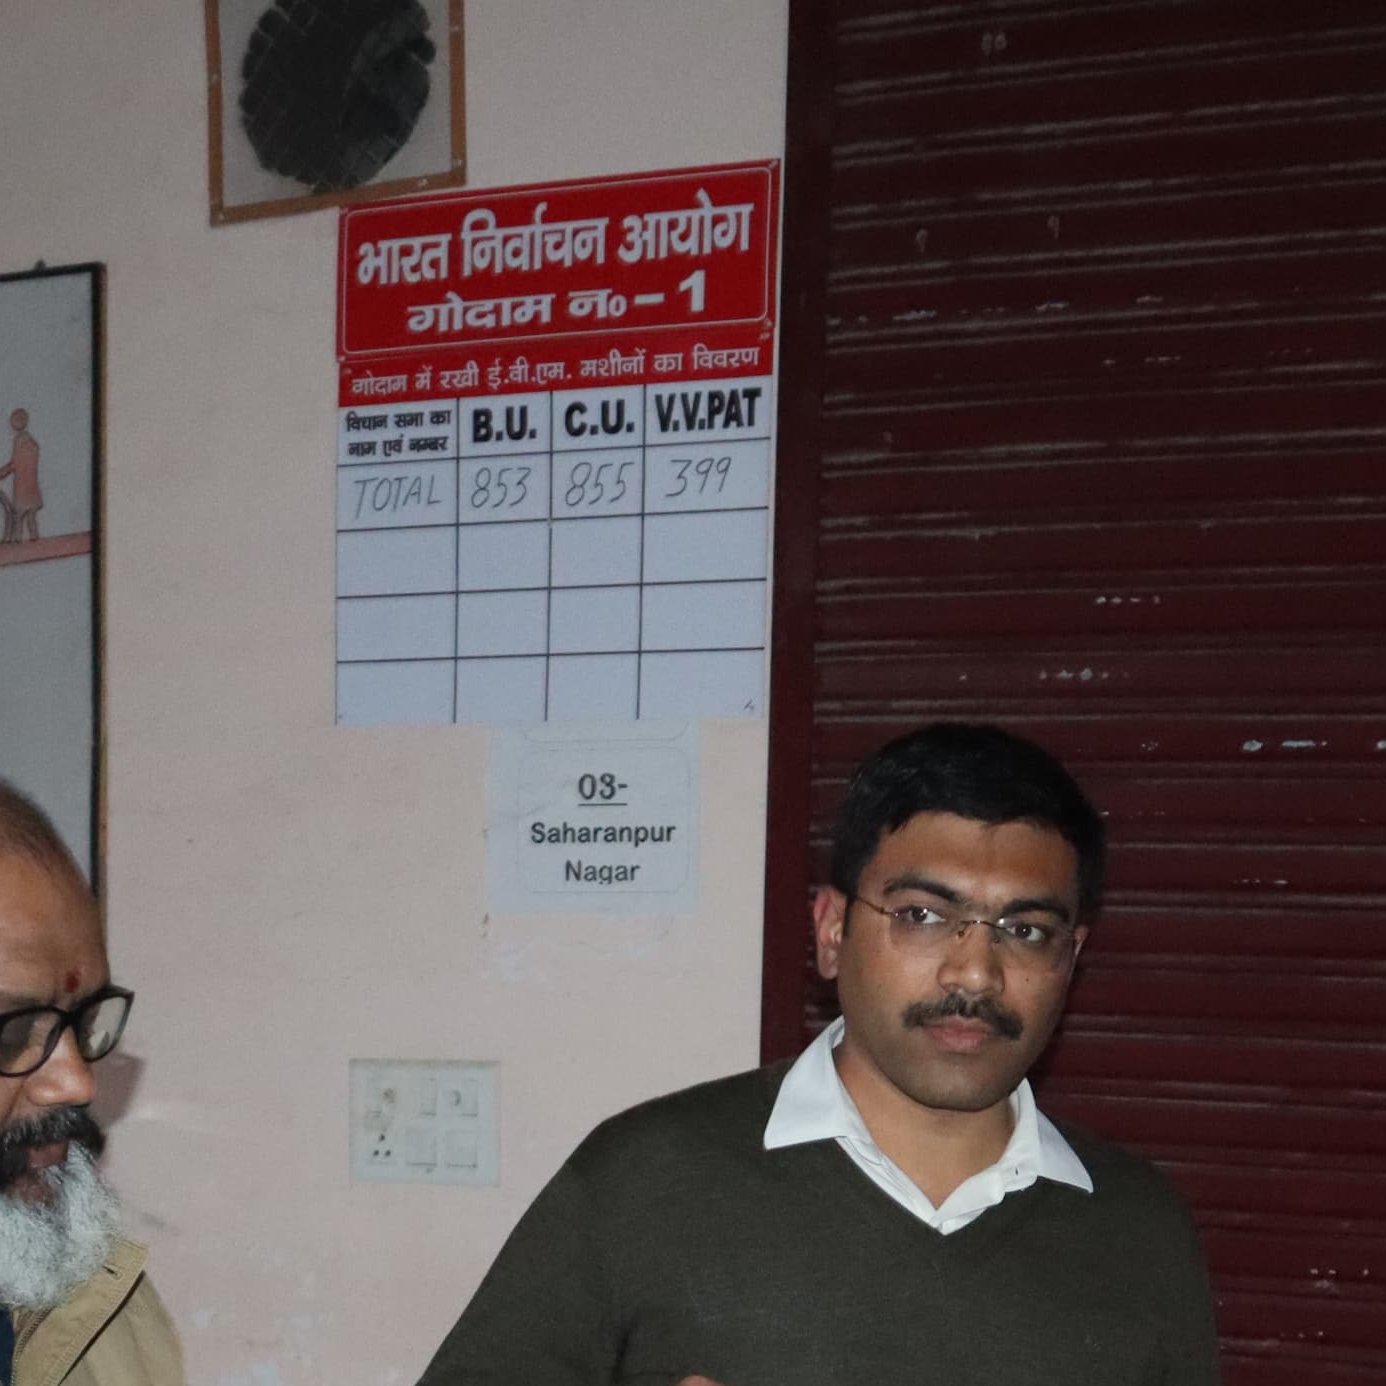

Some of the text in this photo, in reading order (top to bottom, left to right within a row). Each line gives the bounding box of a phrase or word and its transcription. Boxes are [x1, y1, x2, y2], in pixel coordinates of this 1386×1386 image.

[357, 187, 754, 285] भारत निर्वाचन आयोग
[407, 291, 556, 333] गोदाम
[352, 369, 408, 396] गोदाम
[415, 364, 433, 391] में
[439, 359, 480, 388] रखी
[580, 347, 647, 378] मशीनों
[654, 352, 684, 373] का
[692, 342, 761, 370] विवरण
[429, 409, 452, 425] का
[472, 405, 537, 443] B.U.
[564, 398, 635, 437] C.U.
[655, 386, 762, 433] V.V.PAT
[348, 440, 376, 457] नाम
[382, 434, 403, 456] एवं
[354, 474, 442, 520] TOTAL
[471, 466, 533, 508] 853
[565, 461, 636, 507] 855
[664, 456, 732, 498] 399
[530, 821, 676, 848] Saharanpur
[564, 859, 640, 885] Nagar
